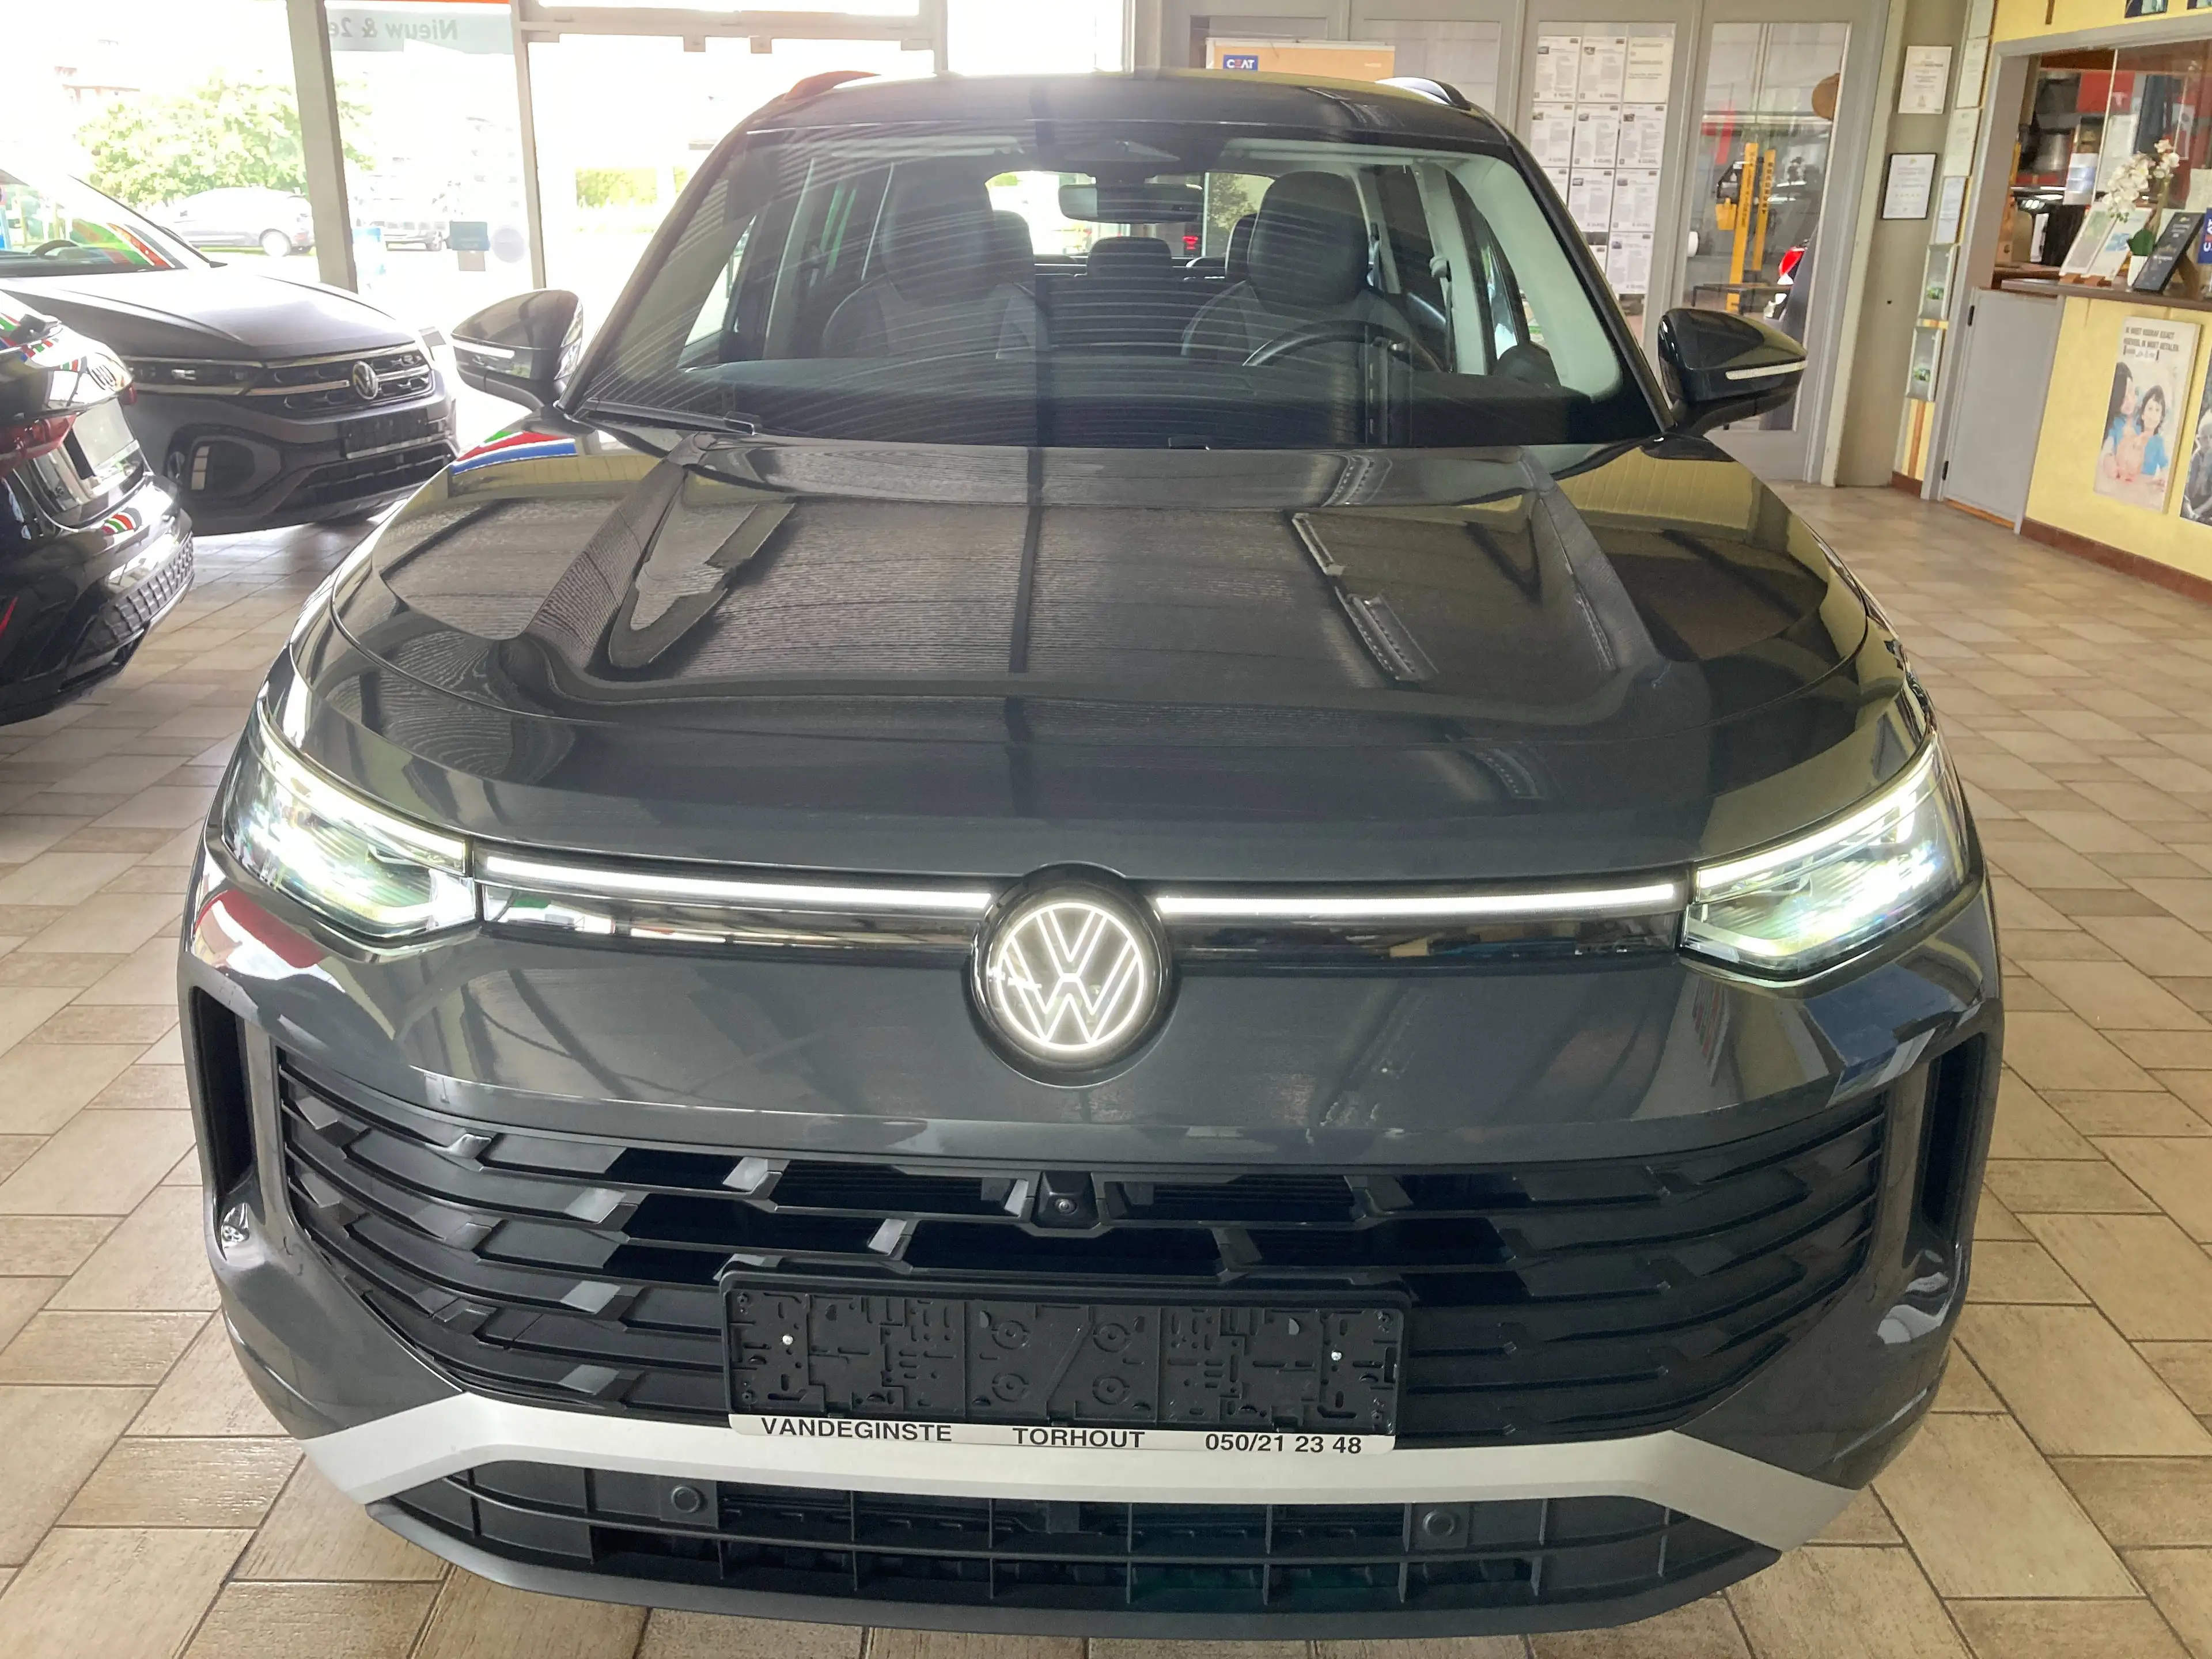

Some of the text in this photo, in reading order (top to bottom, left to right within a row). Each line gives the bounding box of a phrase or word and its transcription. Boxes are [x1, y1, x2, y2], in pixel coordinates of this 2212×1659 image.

[761, 1417, 1362, 1454] VANDEGINSTE TORHOUT 050/21 23 48
